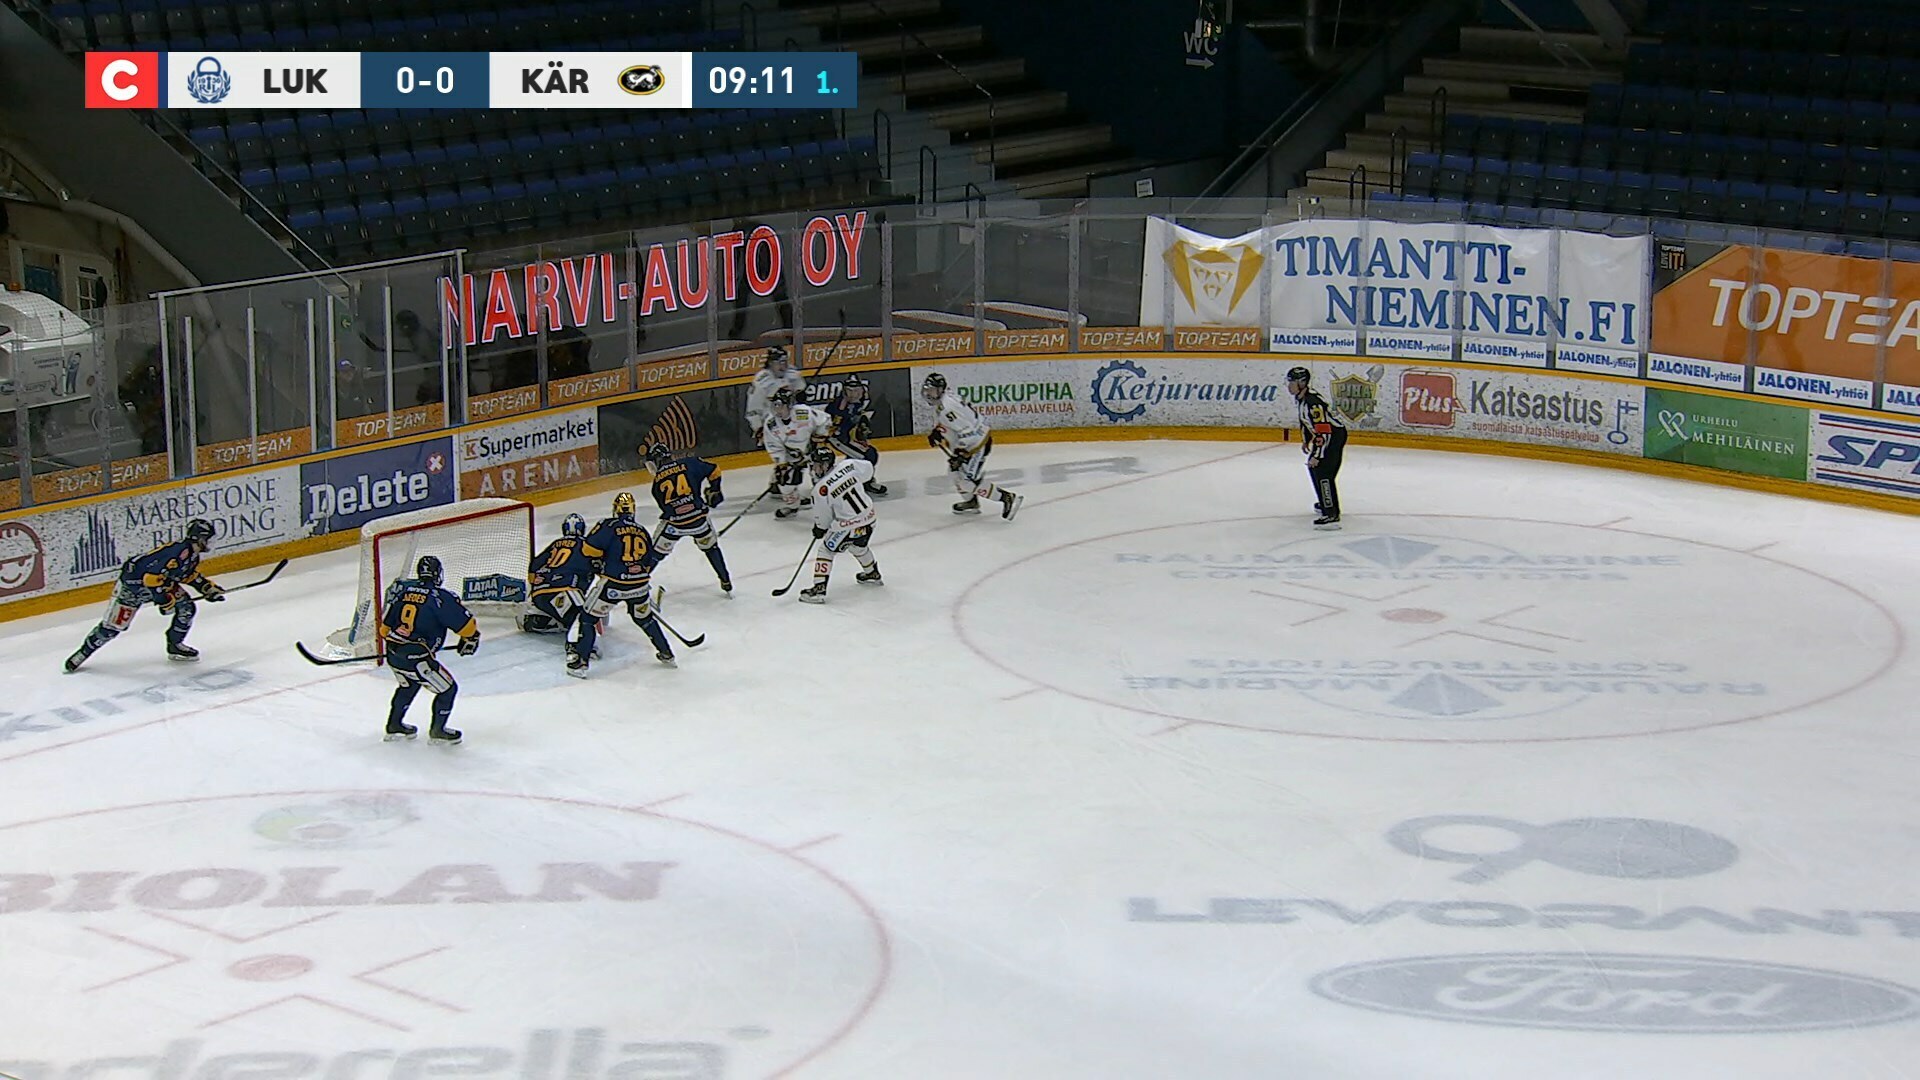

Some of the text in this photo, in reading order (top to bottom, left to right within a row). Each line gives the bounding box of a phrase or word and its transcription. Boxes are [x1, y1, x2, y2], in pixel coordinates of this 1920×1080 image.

[1275, 236, 1527, 284] TIMANTTI-
[437, 210, 869, 350] NARVI-AUTO OY
[1326, 284, 1637, 345] NIEMINEN.FI
[895, 335, 974, 354] TOPTEAM
[987, 331, 1065, 349] TOPTEAM
[1082, 330, 1160, 346] TOPTEAM
[1177, 329, 1257, 346] TOPTEAM
[1272, 332, 1355, 348] JALONEN-yhtiöt
[1368, 336, 1451, 353] JALONEN-yhtiöt
[1463, 341, 1546, 361] JALONEN-yhtiöt
[806, 342, 880, 364] TOPTEAM
[640, 359, 708, 384] TOPTEAM
[1650, 357, 1742, 385] JALONEN-yhtiöt
[957, 382, 1074, 404] PURKUPIHA
[1108, 374, 1278, 404] Ketjurauma
[1338, 383, 1373, 399] PIHA
[1757, 371, 1869, 401] JALONEN-yhtiöt
[472, 391, 537, 416] TOPTEAM
[974, 402, 1074, 416] EMPAA PALVELUA
[1403, 386, 1451, 414] Plus
[1470, 380, 1603, 426] Katsastus
[356, 412, 427, 438] TOPTEAM
[1472, 421, 1523, 435] suomalaista
[1692, 414, 1739, 428] URHEILU
[479, 416, 595, 459] Supermarket
[1692, 430, 1796, 456] MEHILÄINEN
[1816, 434, 1920, 475] SP
[479, 454, 583, 497] ARENA
[659, 473, 692, 504] 24
[125, 478, 276, 530] MARESTONE
[308, 470, 429, 522] Delete
[842, 486, 868, 515] 11
[152, 507, 276, 549] BUDING
[1114, 553, 1682, 567] RAUMA MARINE
[468, 578, 498, 592] LATAA
[401, 603, 417, 632] 9
[0, 861, 677, 914] BIOLAN
[1434, 966, 1788, 1017] Ford
